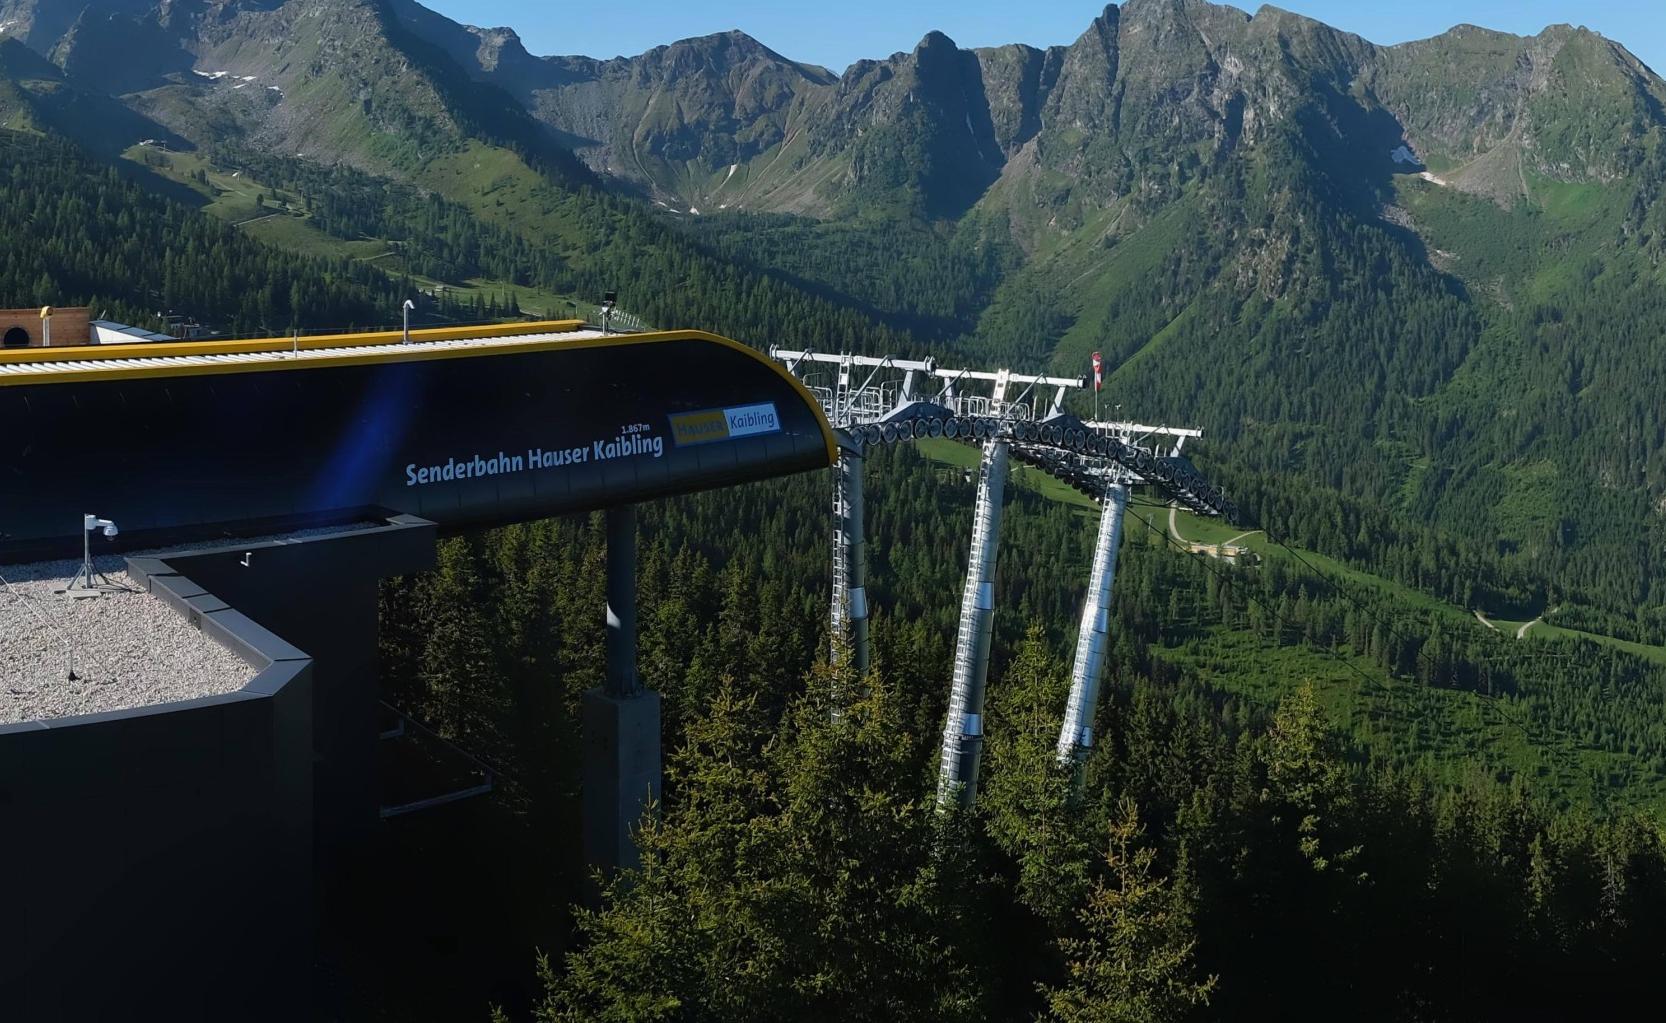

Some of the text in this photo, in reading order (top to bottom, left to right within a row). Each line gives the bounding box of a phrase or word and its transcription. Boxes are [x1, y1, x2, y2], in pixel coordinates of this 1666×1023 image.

[621, 423, 650, 434] 1.867m
[730, 412, 774, 429] Kaibling
[406, 434, 663, 486] Senderbahn Hauser Kaibling
